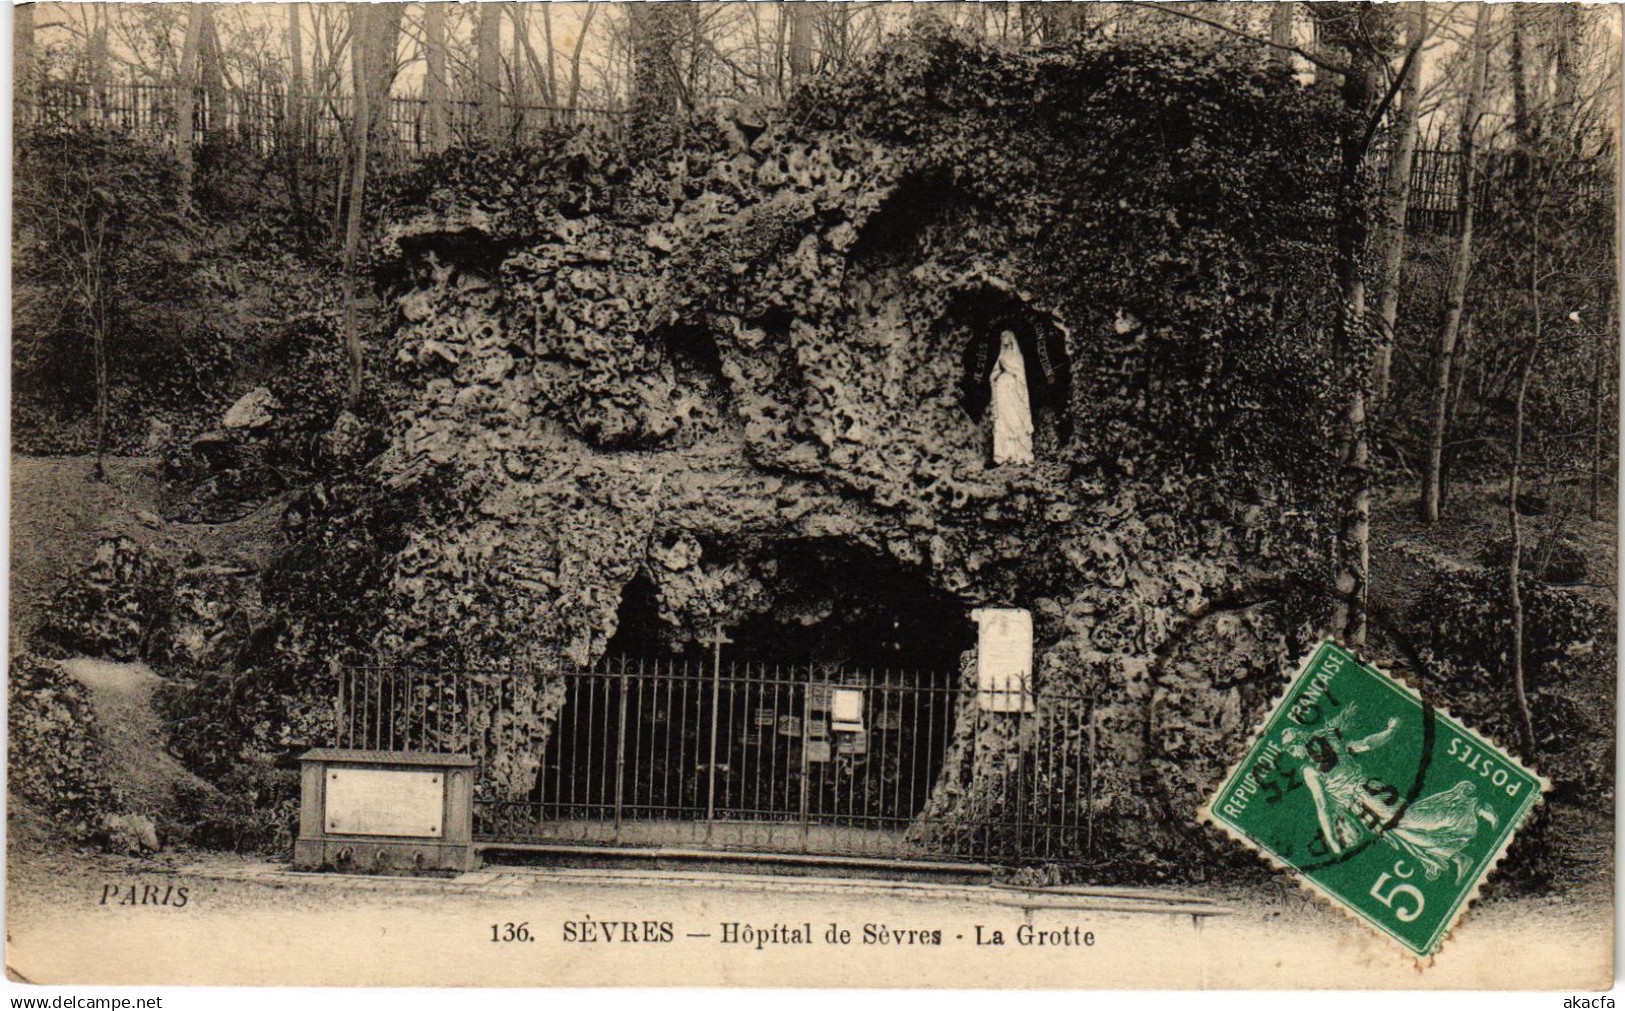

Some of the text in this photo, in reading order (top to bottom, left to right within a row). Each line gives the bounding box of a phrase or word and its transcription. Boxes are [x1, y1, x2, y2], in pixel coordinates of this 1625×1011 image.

[1223, 740, 1283, 819] REPUBQUE
[1447, 737, 1522, 797] POSTES
[99, 884, 189, 908] PARIS
[489, 921, 535, 943] 136.
[562, 914, 675, 943] SÈVRES
[720, 922, 812, 950] Hôpital
[825, 924, 851, 945] de
[862, 924, 942, 945] Sèvres
[974, 925, 1005, 946] La
[1016, 925, 1096, 946] Grotte
